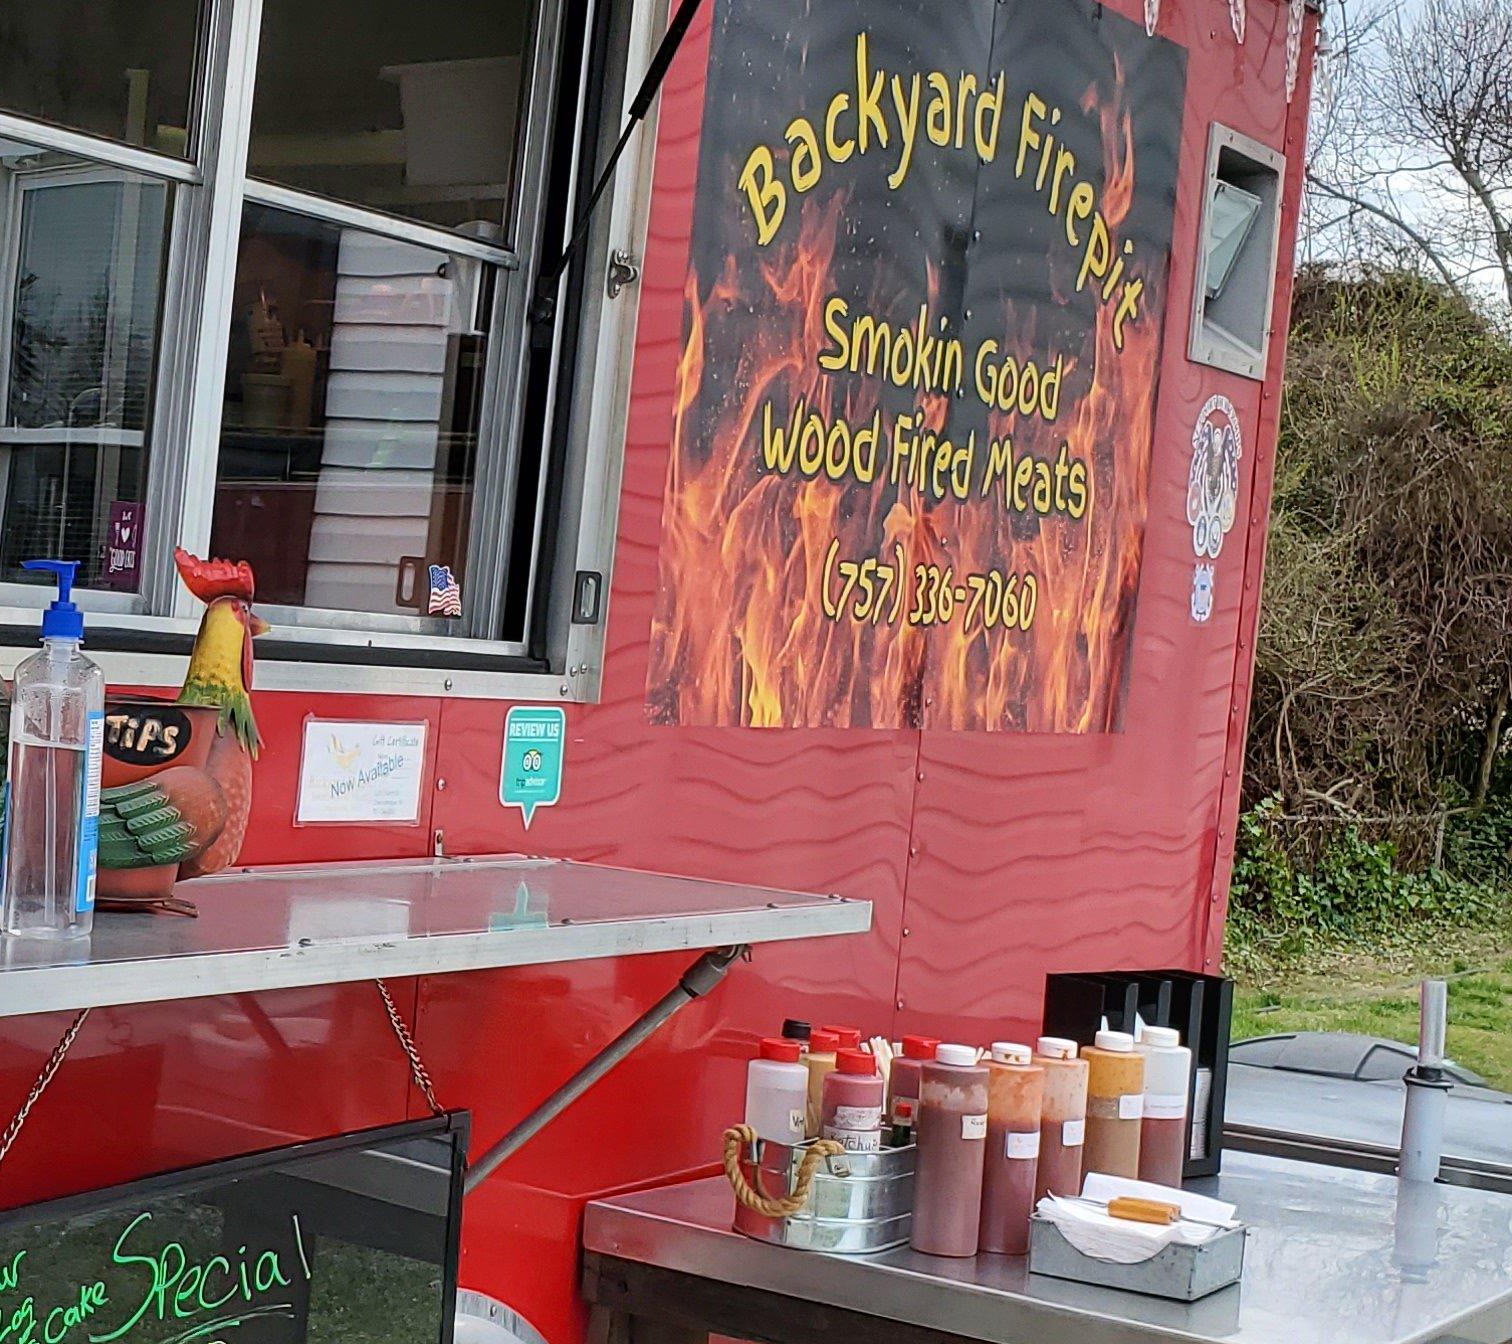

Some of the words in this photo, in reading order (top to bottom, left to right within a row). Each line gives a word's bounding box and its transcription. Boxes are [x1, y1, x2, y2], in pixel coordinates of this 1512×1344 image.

[737, 30, 1006, 246] Backyard
[1015, 92, 1145, 350] Firepit
[819, 298, 964, 396] Smokin
[975, 340, 1064, 421] Good
[762, 398, 881, 484] Wood
[891, 412, 978, 501] Fired
[982, 443, 1089, 521] Meats
[821, 538, 907, 625] (757)
[910, 562, 1038, 633] 336-7060
[330, 777, 356, 799] Now
[357, 754, 405, 788] Available
[509, 722, 545, 737] REVIEW
[547, 722, 560, 737] US
